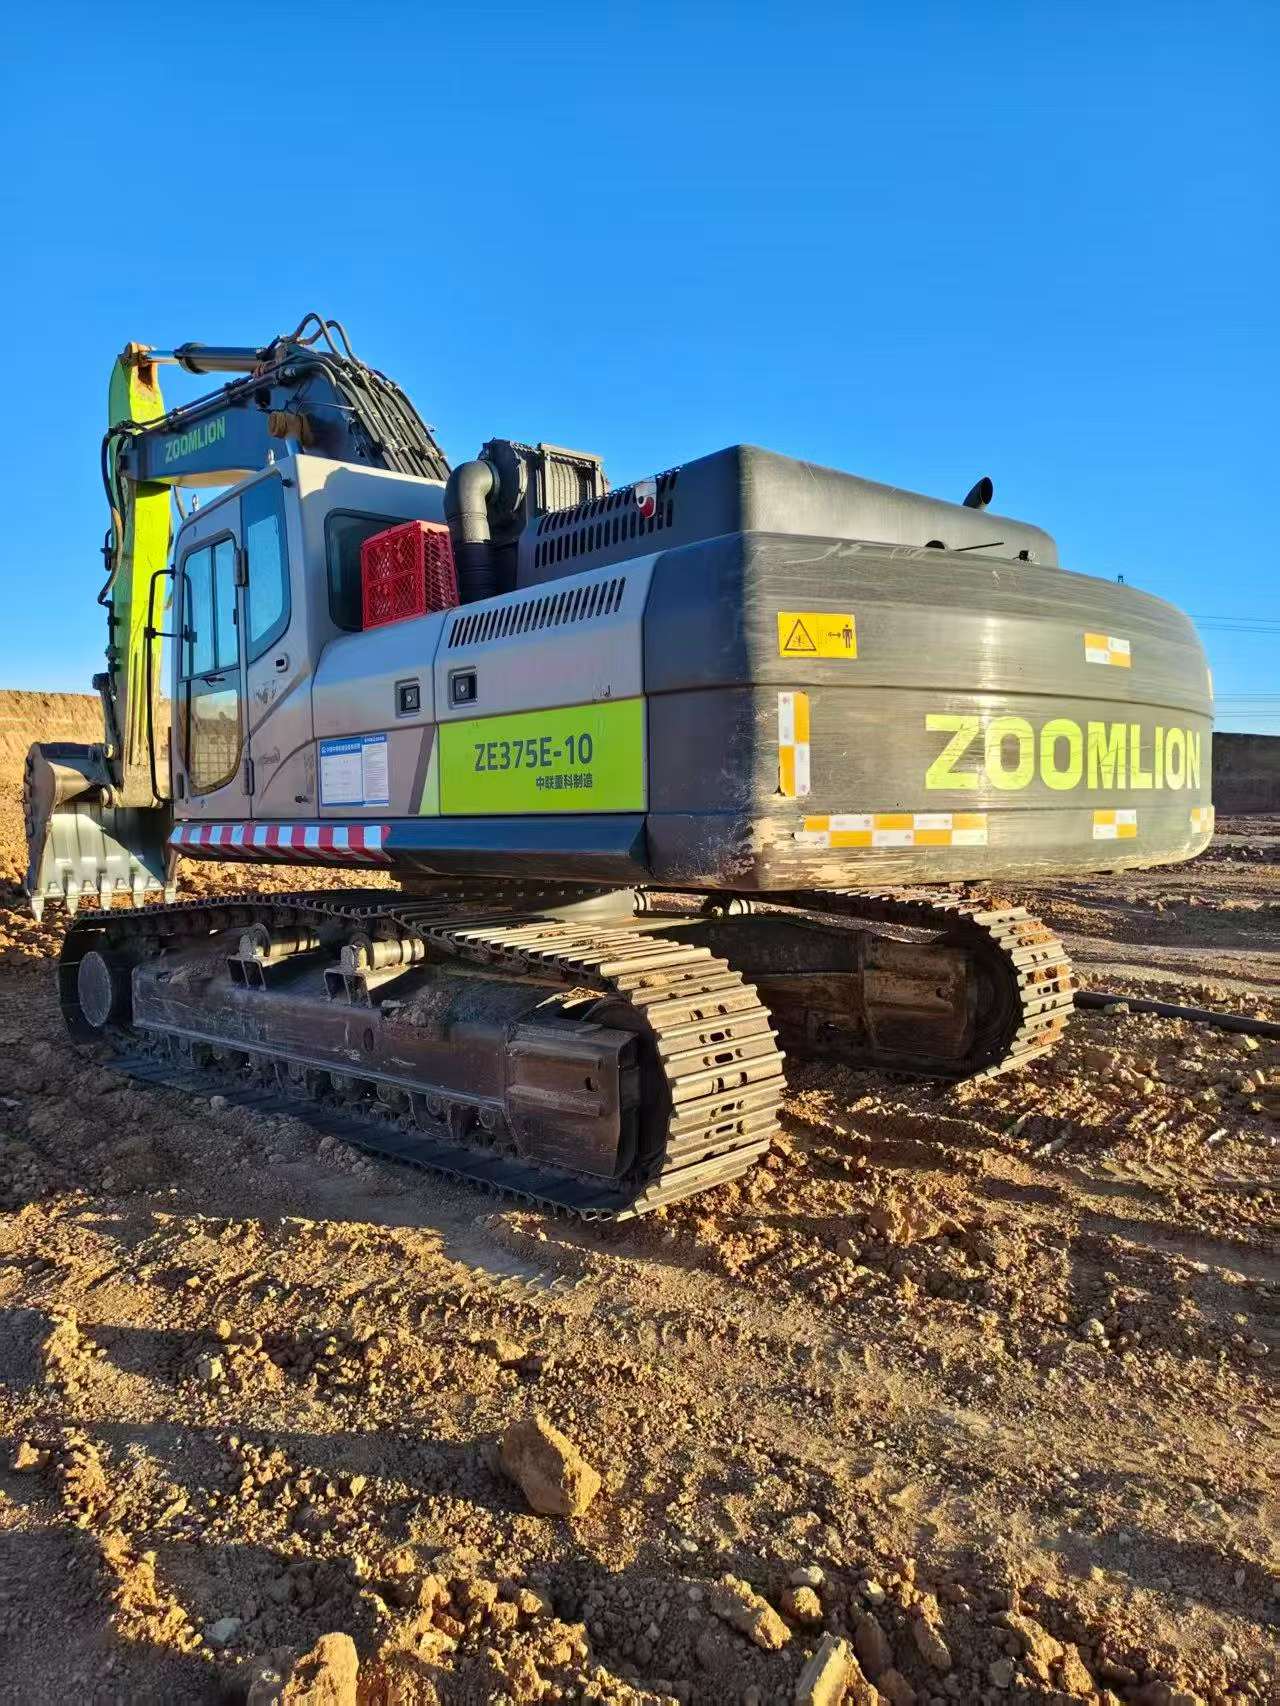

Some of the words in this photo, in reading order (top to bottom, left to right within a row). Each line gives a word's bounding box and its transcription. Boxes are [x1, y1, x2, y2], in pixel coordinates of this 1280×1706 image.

[165, 415, 226, 464] ZOOMLION
[474, 733, 593, 772] ZE375E-10
[925, 713, 1201, 791] ZOOMLION
[535, 773, 593, 790] 中联重科制造
